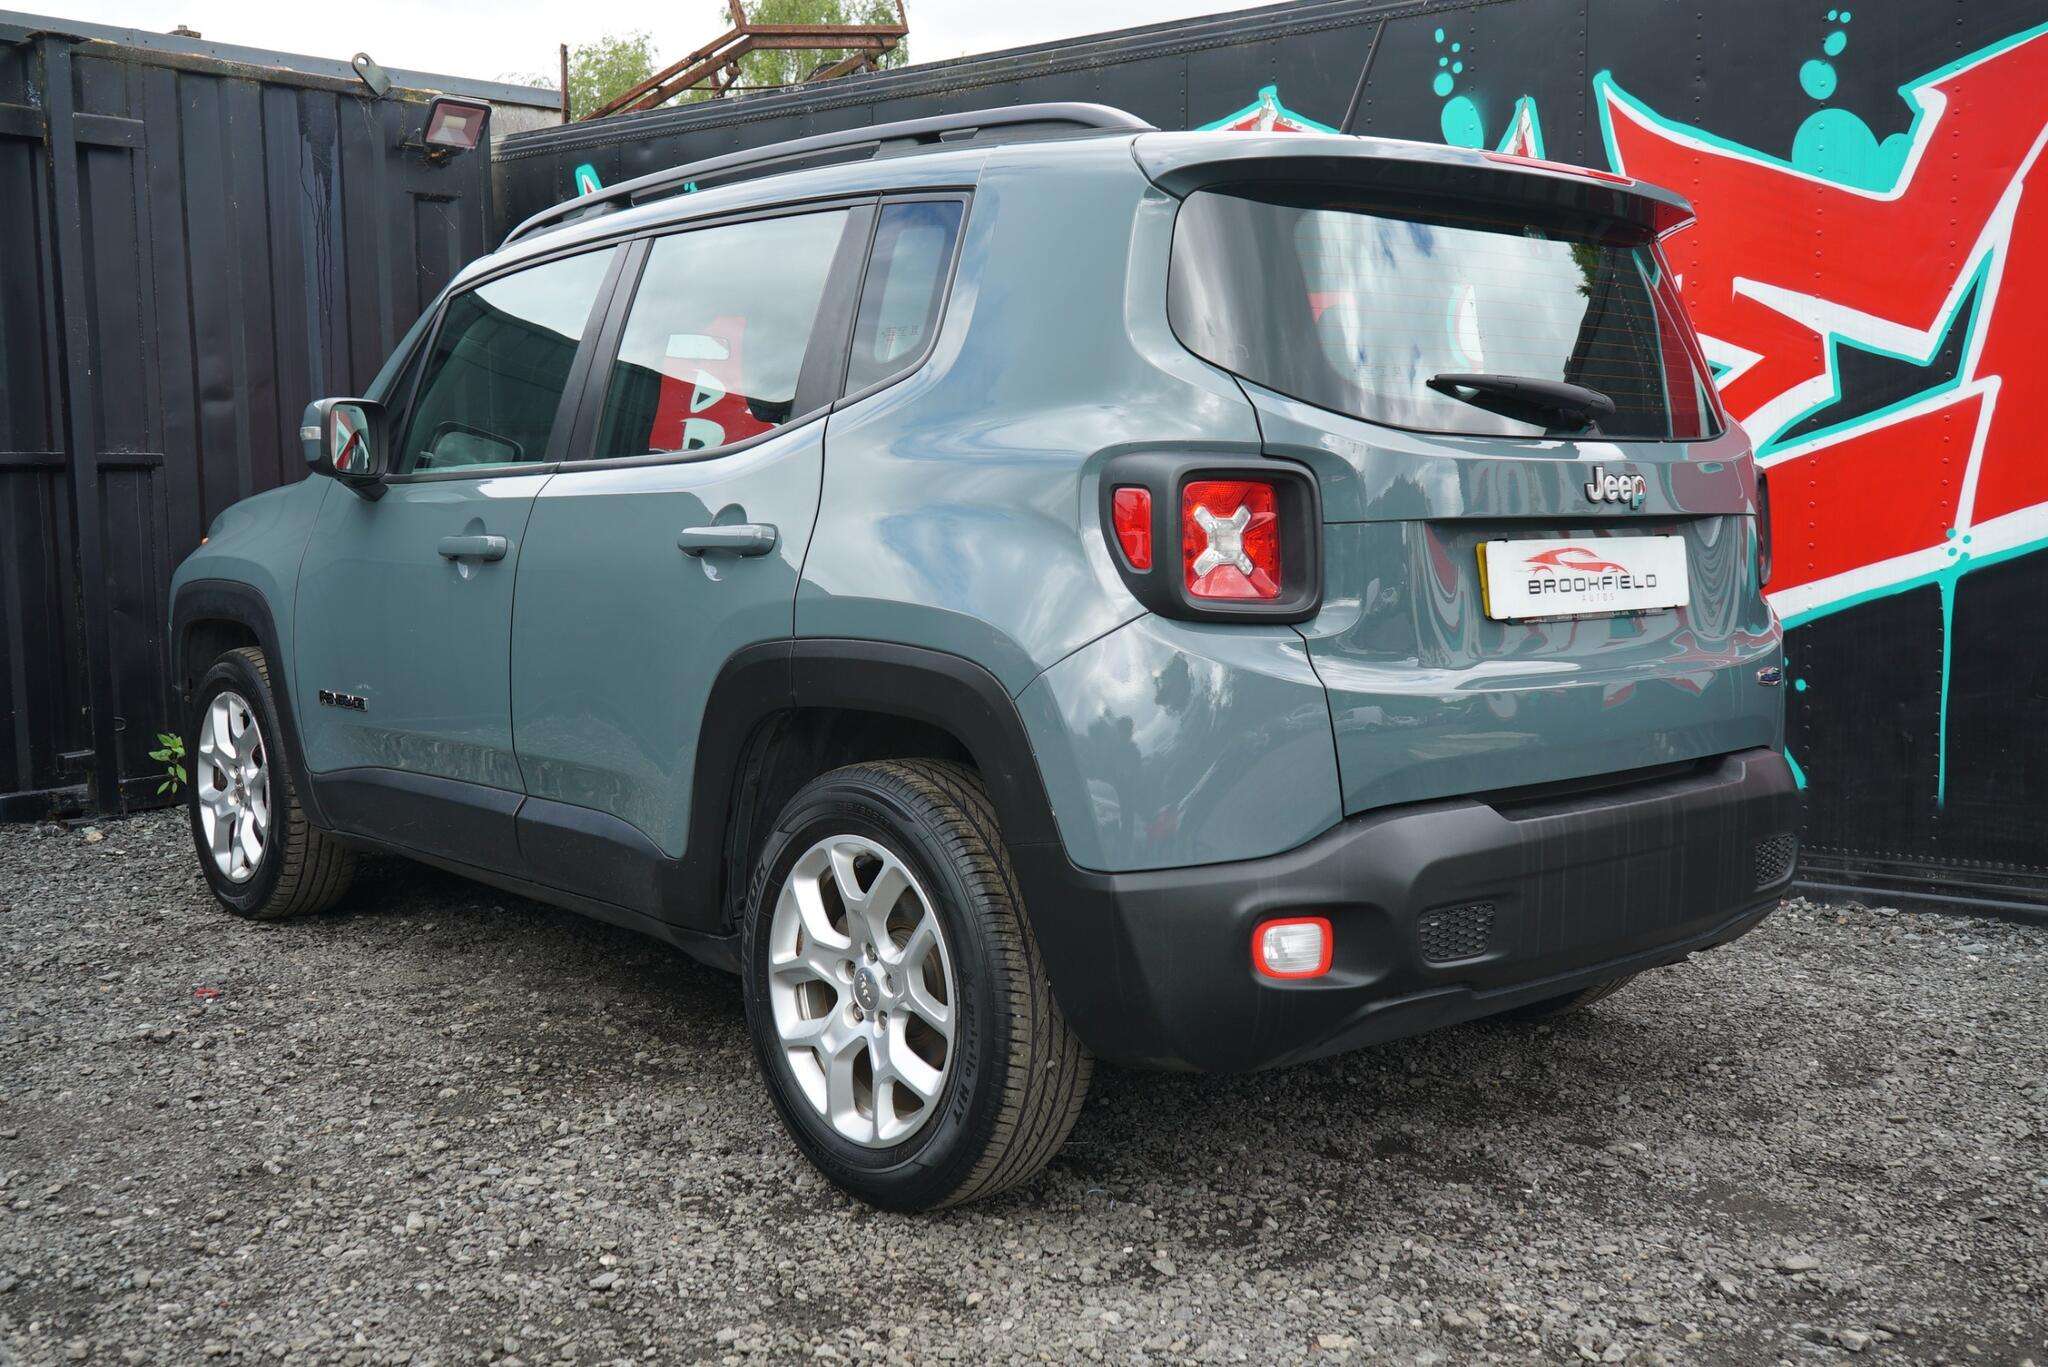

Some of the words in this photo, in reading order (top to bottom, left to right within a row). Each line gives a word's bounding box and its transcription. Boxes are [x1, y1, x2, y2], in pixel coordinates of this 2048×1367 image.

[1585, 465, 1647, 510] Jeep
[1528, 573, 1657, 595] BROOKFIELD
[1581, 593, 1615, 603] AUTOS
